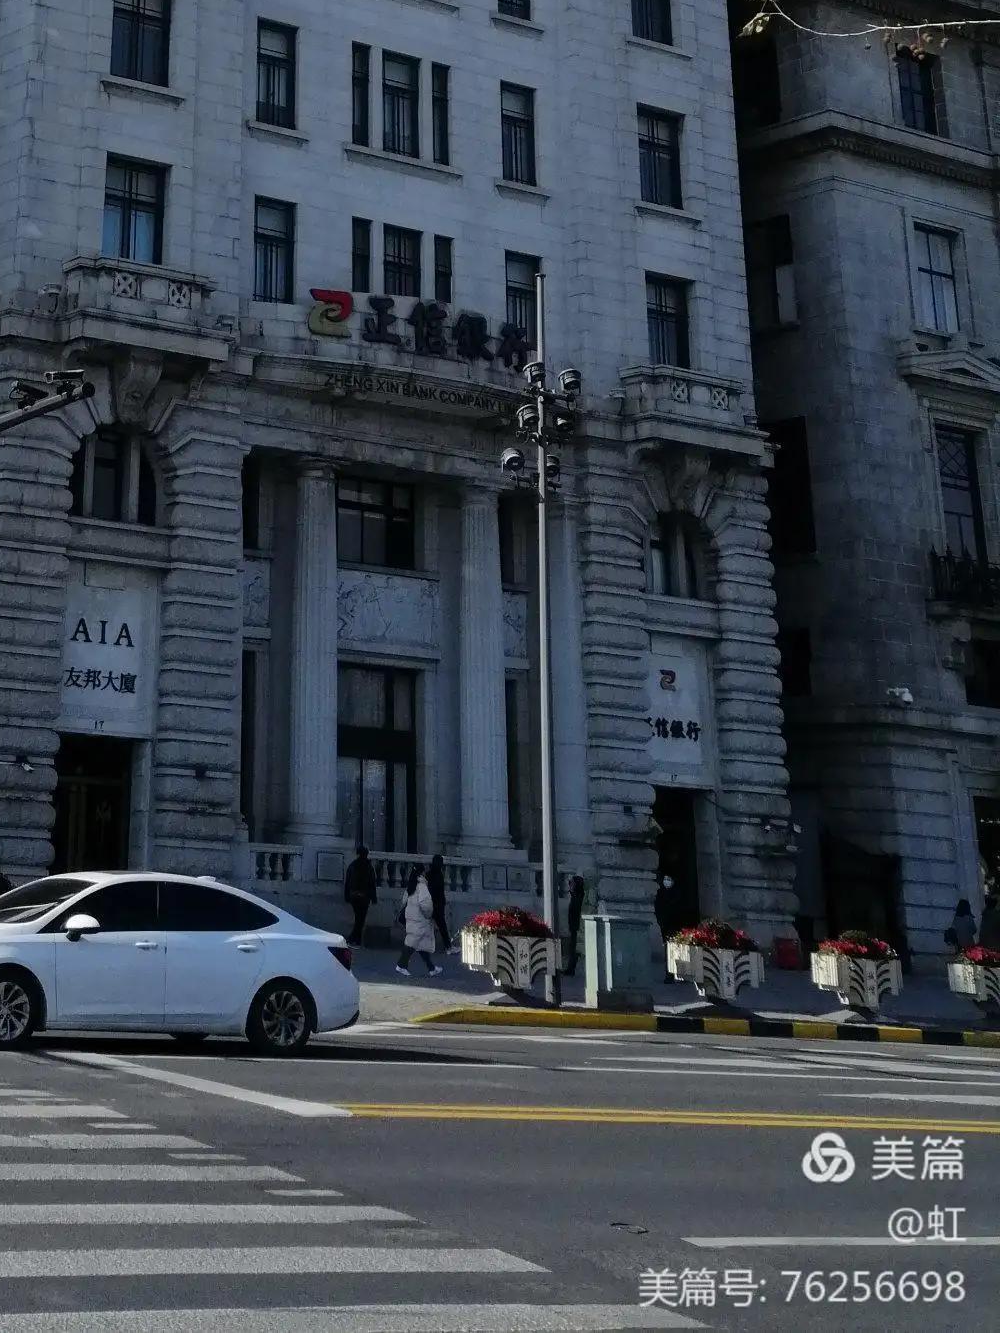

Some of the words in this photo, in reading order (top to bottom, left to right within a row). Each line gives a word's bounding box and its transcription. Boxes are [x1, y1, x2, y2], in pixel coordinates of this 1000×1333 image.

[324, 373, 373, 392] ZHENG
[377, 378, 399, 394] XIN
[402, 382, 439, 400] BANK
[439, 390, 496, 412] COMPANY
[70, 617, 135, 647] AIA
[94, 720, 104, 731] 17
